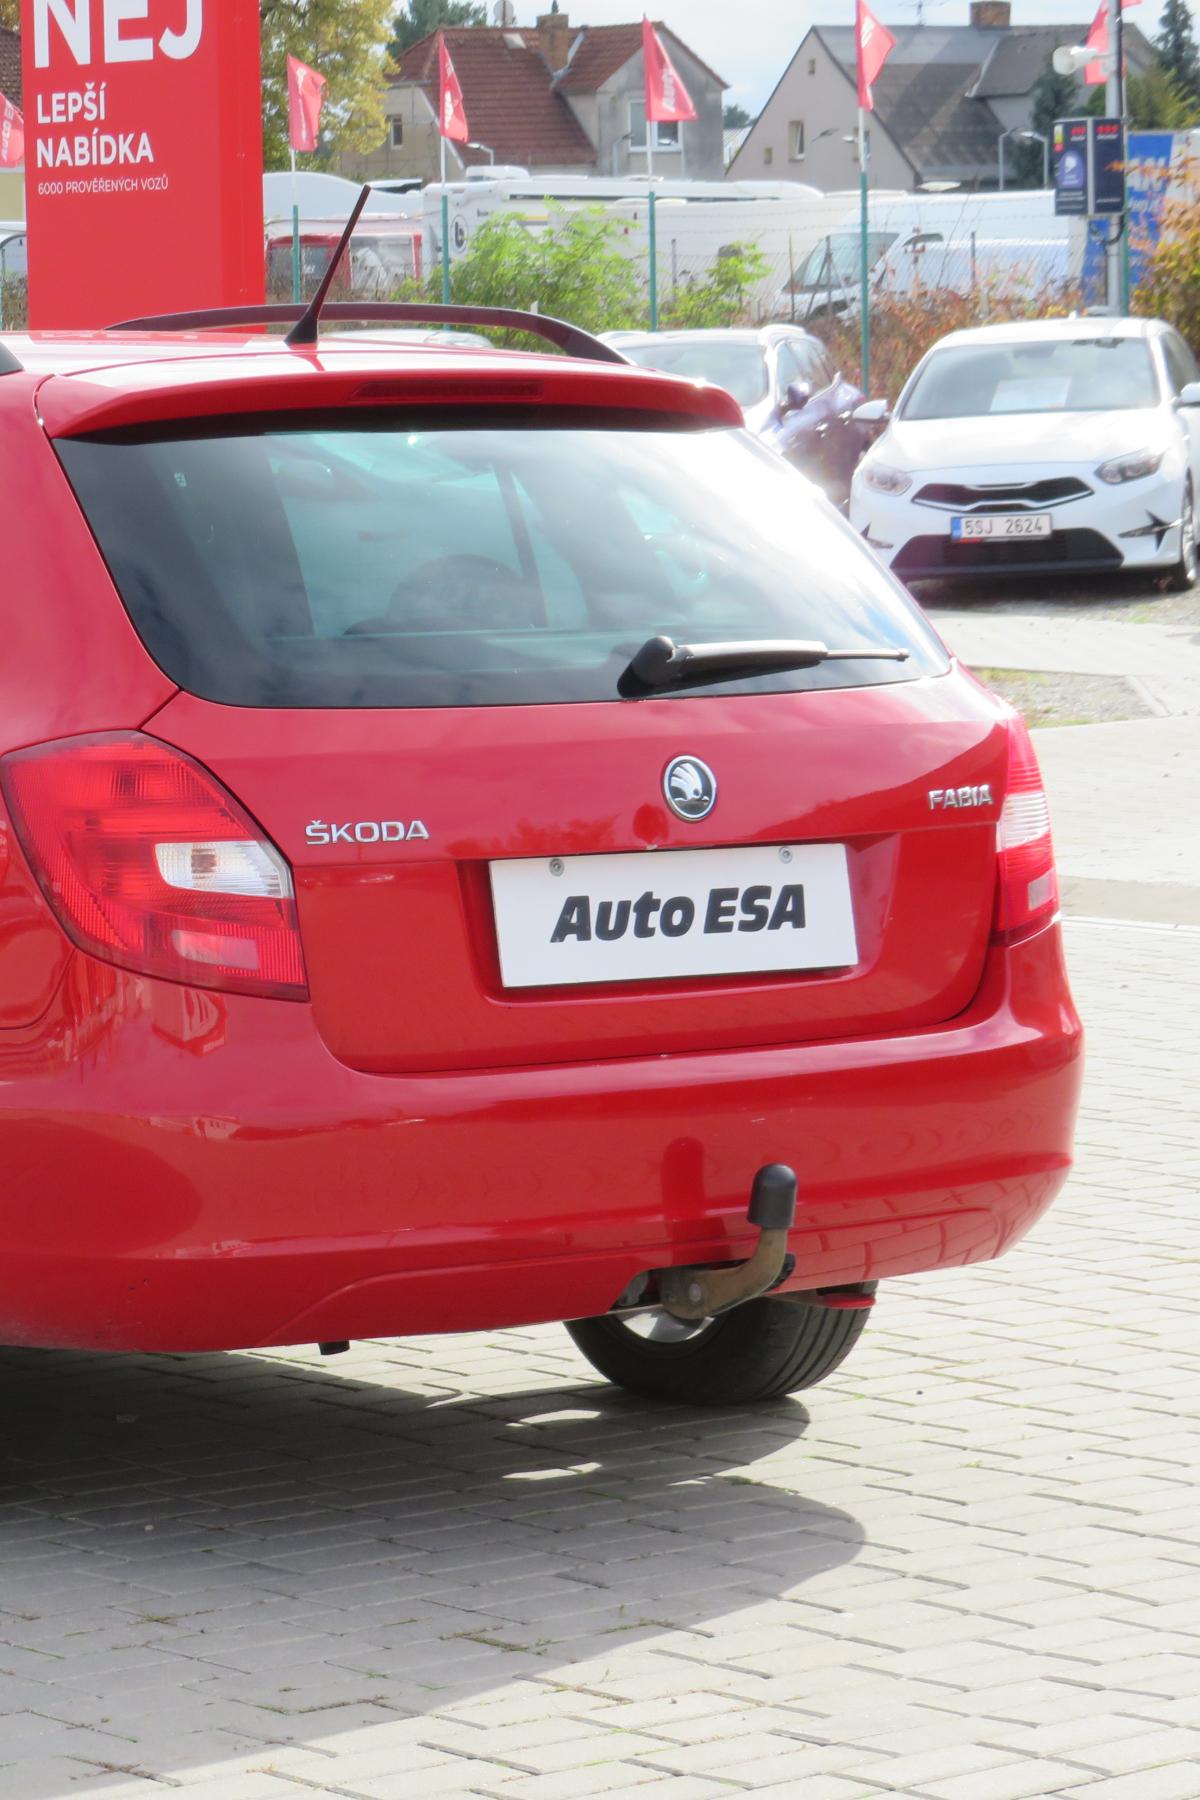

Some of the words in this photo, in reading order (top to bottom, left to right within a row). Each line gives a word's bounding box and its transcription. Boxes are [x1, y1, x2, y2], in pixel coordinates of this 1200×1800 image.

[33, 0, 202, 68] NEJ
[37, 82, 107, 124] LEPŠÍ
[36, 128, 154, 168] NABÍDKA
[38, 182, 63, 195] 6000
[66, 177, 138, 193] PROVĚŘENÝCH
[141, 173, 168, 190] VOZŮ
[965, 520, 993, 535] 5SJ
[928, 784, 993, 810] FABIA
[305, 819, 430, 845] ŠKODA
[550, 891, 695, 943] Auto
[703, 884, 806, 934] ESA
